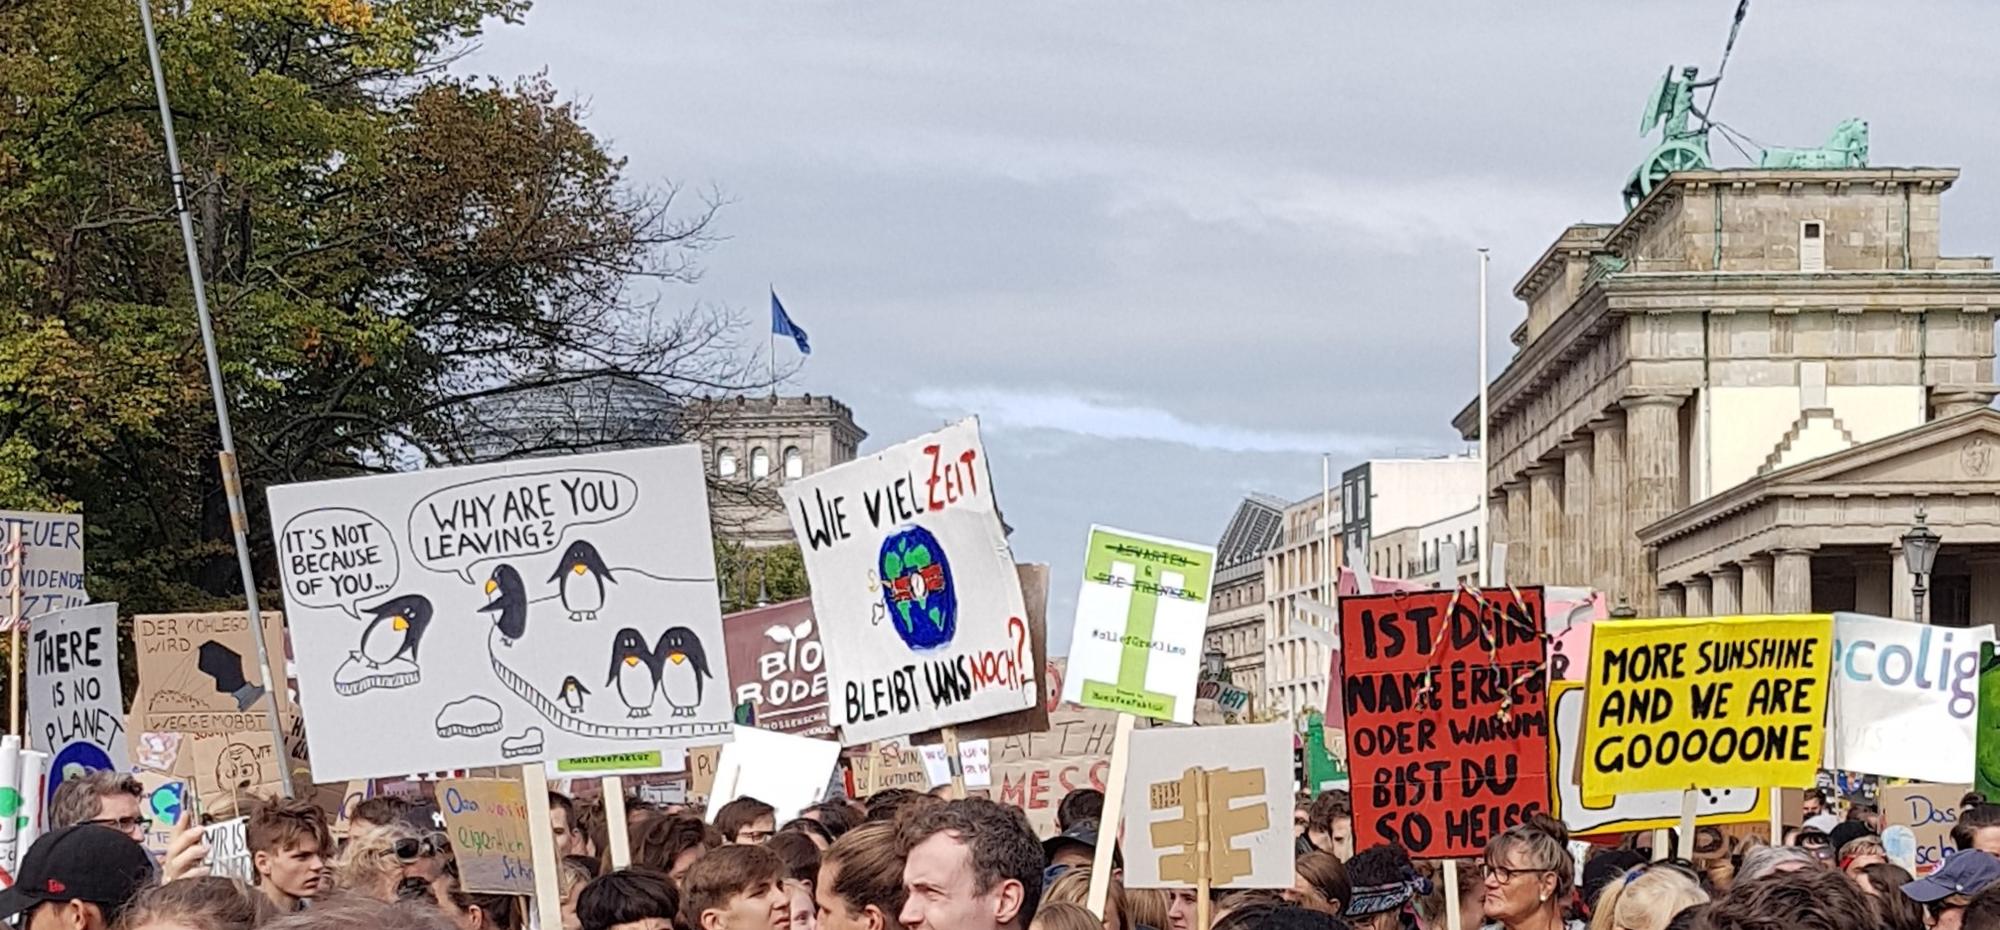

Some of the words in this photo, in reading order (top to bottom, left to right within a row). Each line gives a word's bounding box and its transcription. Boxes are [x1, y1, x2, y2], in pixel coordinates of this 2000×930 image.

[429, 494, 501, 533] WHY
[503, 484, 555, 525] ARE
[560, 478, 619, 516] YOU
[799, 487, 851, 551] WIE
[863, 470, 925, 528] VIEL
[923, 444, 976, 512] ZEIT
[286, 527, 327, 553] IT'S
[332, 522, 374, 549] NOT
[291, 546, 382, 576] BECAUSE
[424, 520, 555, 561] LEAVING?
[1, 568, 85, 590] DVIDENDE
[296, 573, 325, 597] OF
[332, 569, 391, 597] YOU...
[142, 620, 179, 637] DER
[187, 615, 271, 635] KOHLEGOT
[144, 637, 192, 654] WIRD
[1361, 606, 1438, 660] IST
[1451, 598, 1537, 651] DEIN
[34, 627, 103, 676] THERE
[758, 630, 823, 681] BIO
[845, 664, 920, 724] BLEIBT
[923, 654, 971, 705] UNS
[969, 616, 1027, 691] NOCH?
[1602, 642, 1688, 686] MORE
[1695, 637, 1818, 675] SUNSHINE
[1835, 627, 1978, 719] colig
[52, 684, 66, 707] IS
[74, 677, 102, 704] NO
[1347, 664, 1443, 716] NAME
[1598, 687, 1673, 728] AND
[1690, 682, 1734, 720] WE
[1746, 678, 1816, 717] ARE
[46, 709, 125, 754] PLANET
[150, 714, 267, 730] WEGGEMOBBT
[1353, 718, 1437, 758] ODER
[1448, 711, 1548, 745] WARUM
[1594, 724, 1812, 773] GOOOOONE
[1372, 760, 1451, 808] BIST
[1461, 754, 1519, 798] DU
[1376, 811, 1432, 851] SO
[1904, 795, 1957, 828] Das
